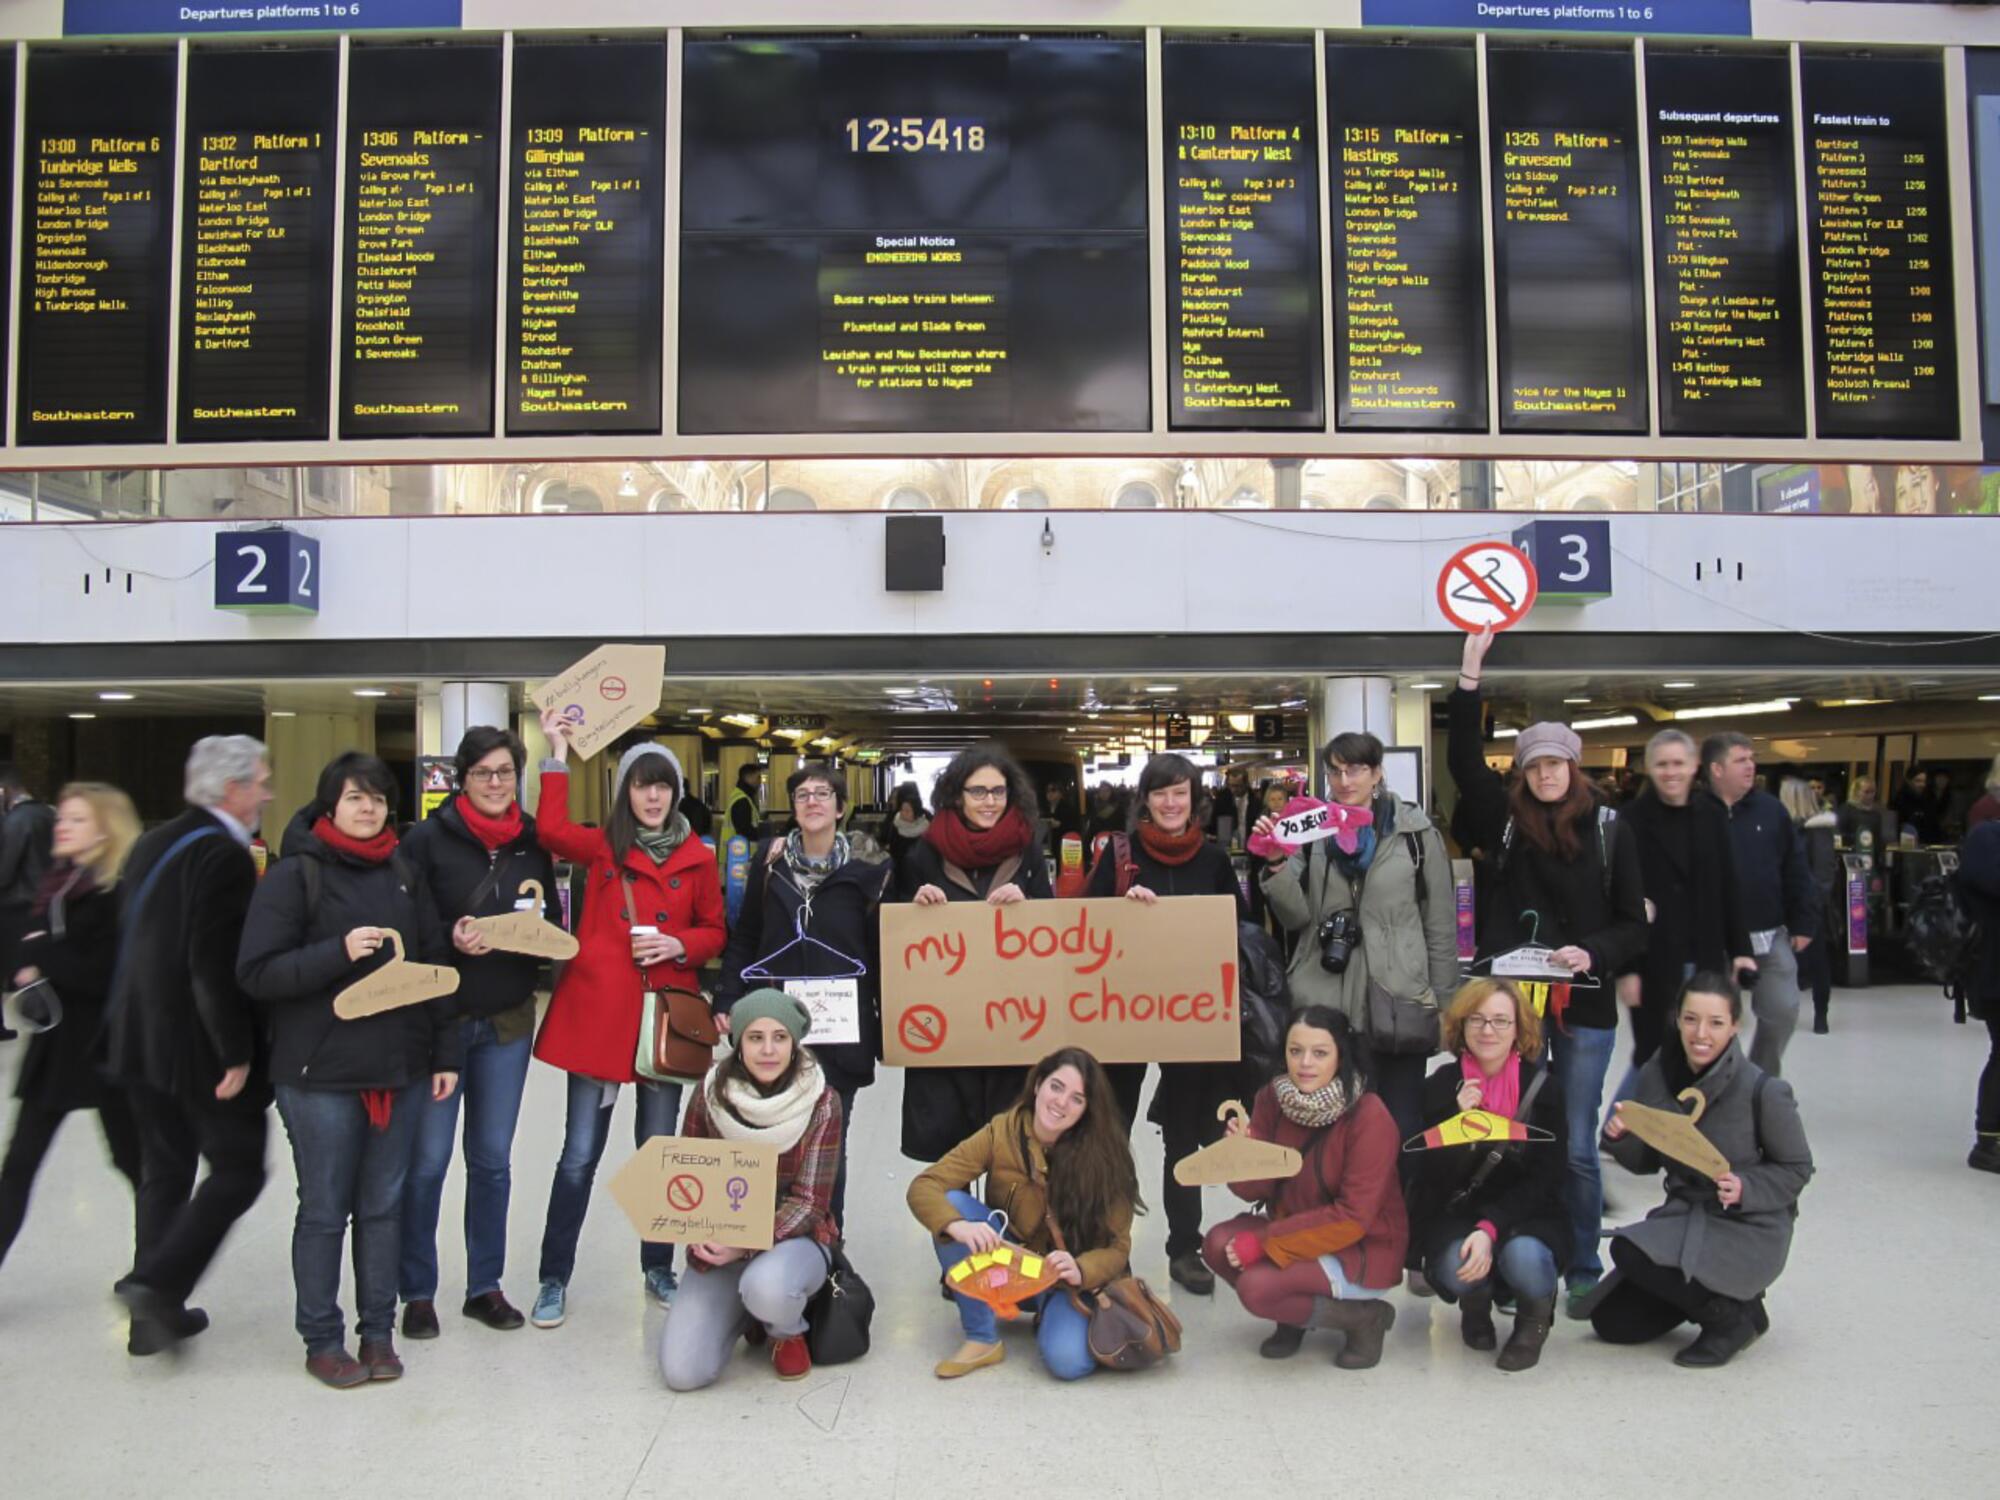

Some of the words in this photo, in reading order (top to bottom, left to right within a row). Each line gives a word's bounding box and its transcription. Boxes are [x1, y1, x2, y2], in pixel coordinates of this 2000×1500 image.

[180, 7, 253, 22] Departures
[257, 5, 320, 20] platforms
[324, 4, 330, 16] 1
[333, 5, 347, 16] to
[350, 3, 360, 15] 6
[1477, 3, 1550, 18] Departures
[1554, 5, 1615, 19] platforms
[1619, 7, 1624, 18] 1
[1628, 7, 1640, 19] to
[1644, 7, 1653, 20] 6
[1659, 110, 1721, 123] Subsequent
[1723, 112, 1779, 124] departures
[1814, 114, 1852, 125] Fastest
[1854, 115, 1877, 125] train
[1880, 116, 1890, 126] to
[364, 130, 400, 146] 13:06
[414, 130, 470, 144] Platform
[528, 128, 564, 144] 13:09
[578, 126, 636, 143] Platform
[847, 118, 949, 152] 12:54
[953, 126, 985, 151] 18
[1180, 124, 1216, 140] 13:10
[1230, 126, 1286, 140] Platform
[1292, 128, 1300, 140] 4
[1344, 127, 1380, 143] 13:15
[1394, 128, 1450, 144] Platform
[1504, 131, 1540, 146] 13:26
[1554, 132, 1608, 148] Platform
[42, 140, 78, 154] 13:00
[90, 138, 146, 152] Platform
[150, 138, 160, 152] 6
[202, 135, 238, 151] 13:02
[254, 133, 308, 150] Platform
[314, 134, 320, 146] 1
[360, 152, 430, 168] Sevenoaks
[1190, 146, 1260, 160] Canterbury
[1260, 146, 1292, 160] West
[1344, 148, 1400, 165] Hastings
[1504, 152, 1572, 167] Gravesend
[40, 160, 104, 176] Tunbridge
[108, 158, 138, 174] Wells
[200, 155, 258, 172] Dartford
[38, 206, 82, 216] Waterloo
[84, 206, 108, 216] East
[38, 220, 72, 230] London
[74, 220, 110, 230] Bridge
[36, 234, 86, 244] Orpington
[876, 236, 917, 248] Special
[920, 236, 956, 247] Notice
[36, 274, 86, 284] Tonbridge
[832, 294, 864, 304] Buses
[868, 294, 910, 304] replace
[912, 294, 948, 304] trains
[948, 294, 992, 304] between:
[354, 404, 460, 416] Southeastern
[520, 398, 630, 413] Southeastern
[1184, 396, 1292, 408] Southeastern
[1350, 398, 1456, 410] Southeastern
[1514, 400, 1616, 413] Southeastern
[32, 410, 134, 420] Southeastern
[192, 406, 296, 419] Southeastern
[1558, 533, 1591, 582] 3
[236, 544, 268, 593] 2
[298, 549, 312, 597] 2
[1263, 719, 1276, 737] 3
[1280, 820, 1298, 838] YO
[903, 932, 967, 976] my
[994, 906, 1124, 975] body,
[985, 995, 1047, 1041] my
[1068, 961, 1236, 1024] choice!
[661, 1145, 721, 1169] FREEDOM
